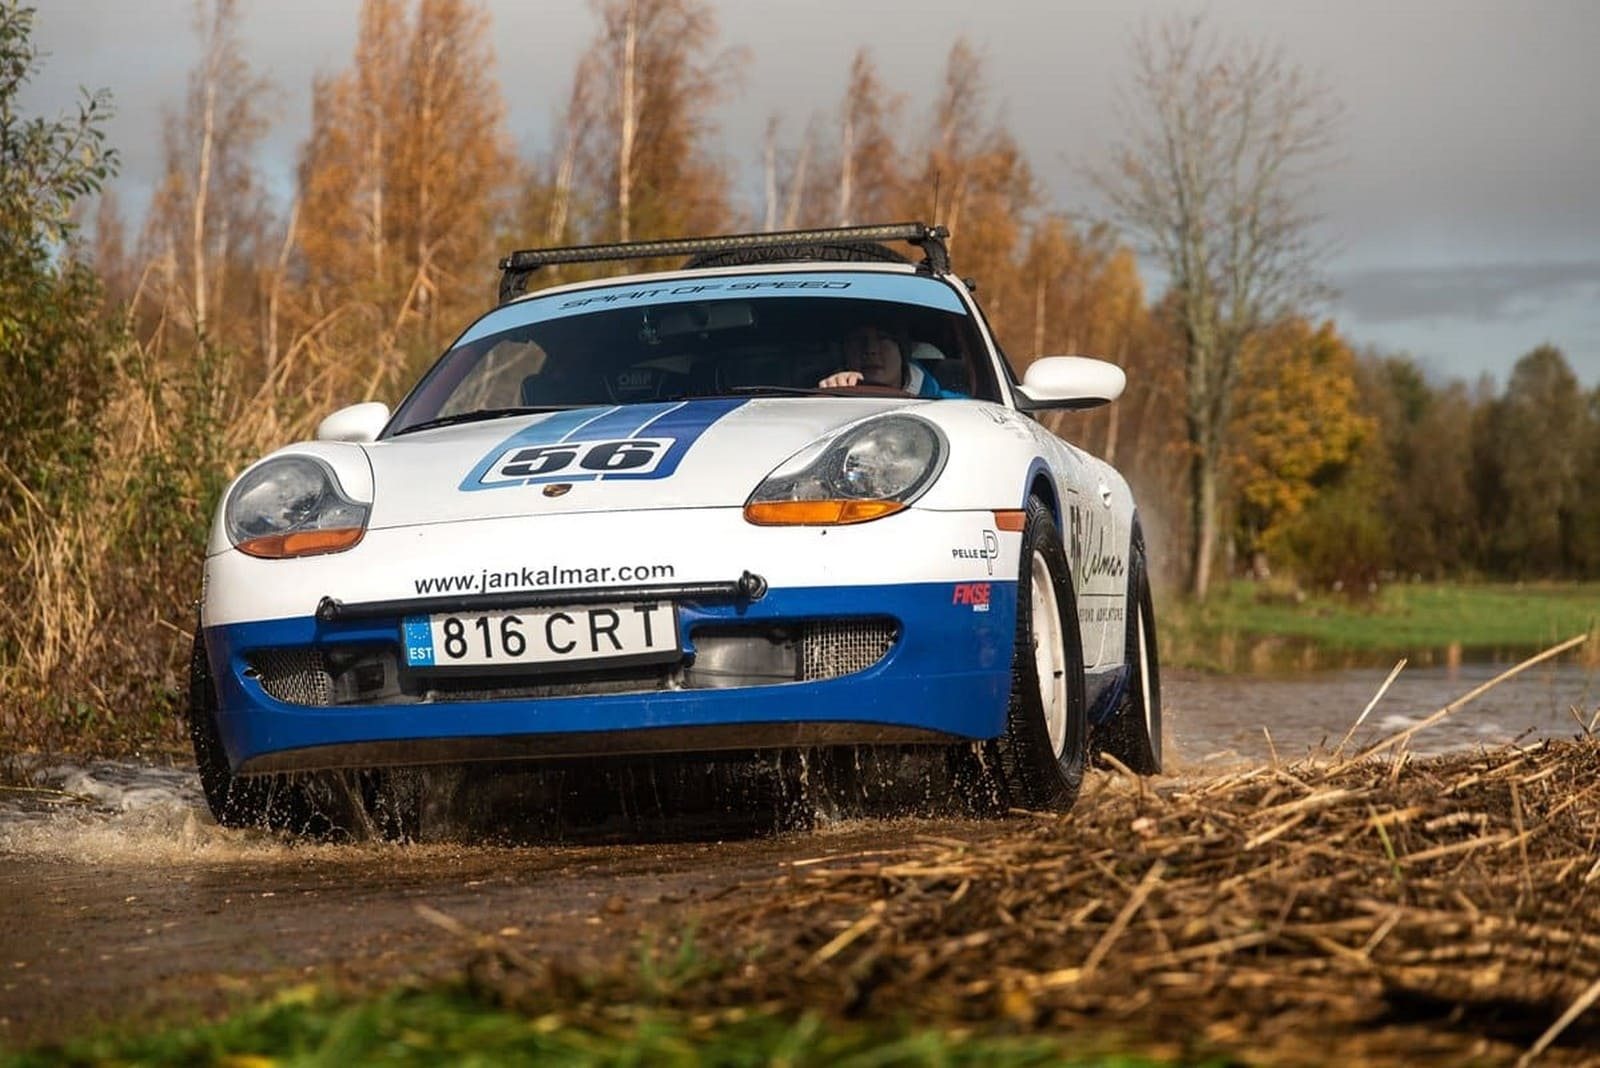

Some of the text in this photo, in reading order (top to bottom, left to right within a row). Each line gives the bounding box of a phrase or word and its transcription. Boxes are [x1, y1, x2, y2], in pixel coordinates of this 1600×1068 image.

[559, 281, 851, 310] SPIRIT OF SPEED
[501, 441, 661, 476] 56
[952, 549, 979, 560] PELLE
[414, 564, 675, 594] www.jankalmar.com
[410, 603, 659, 660] EST 816 CRT
